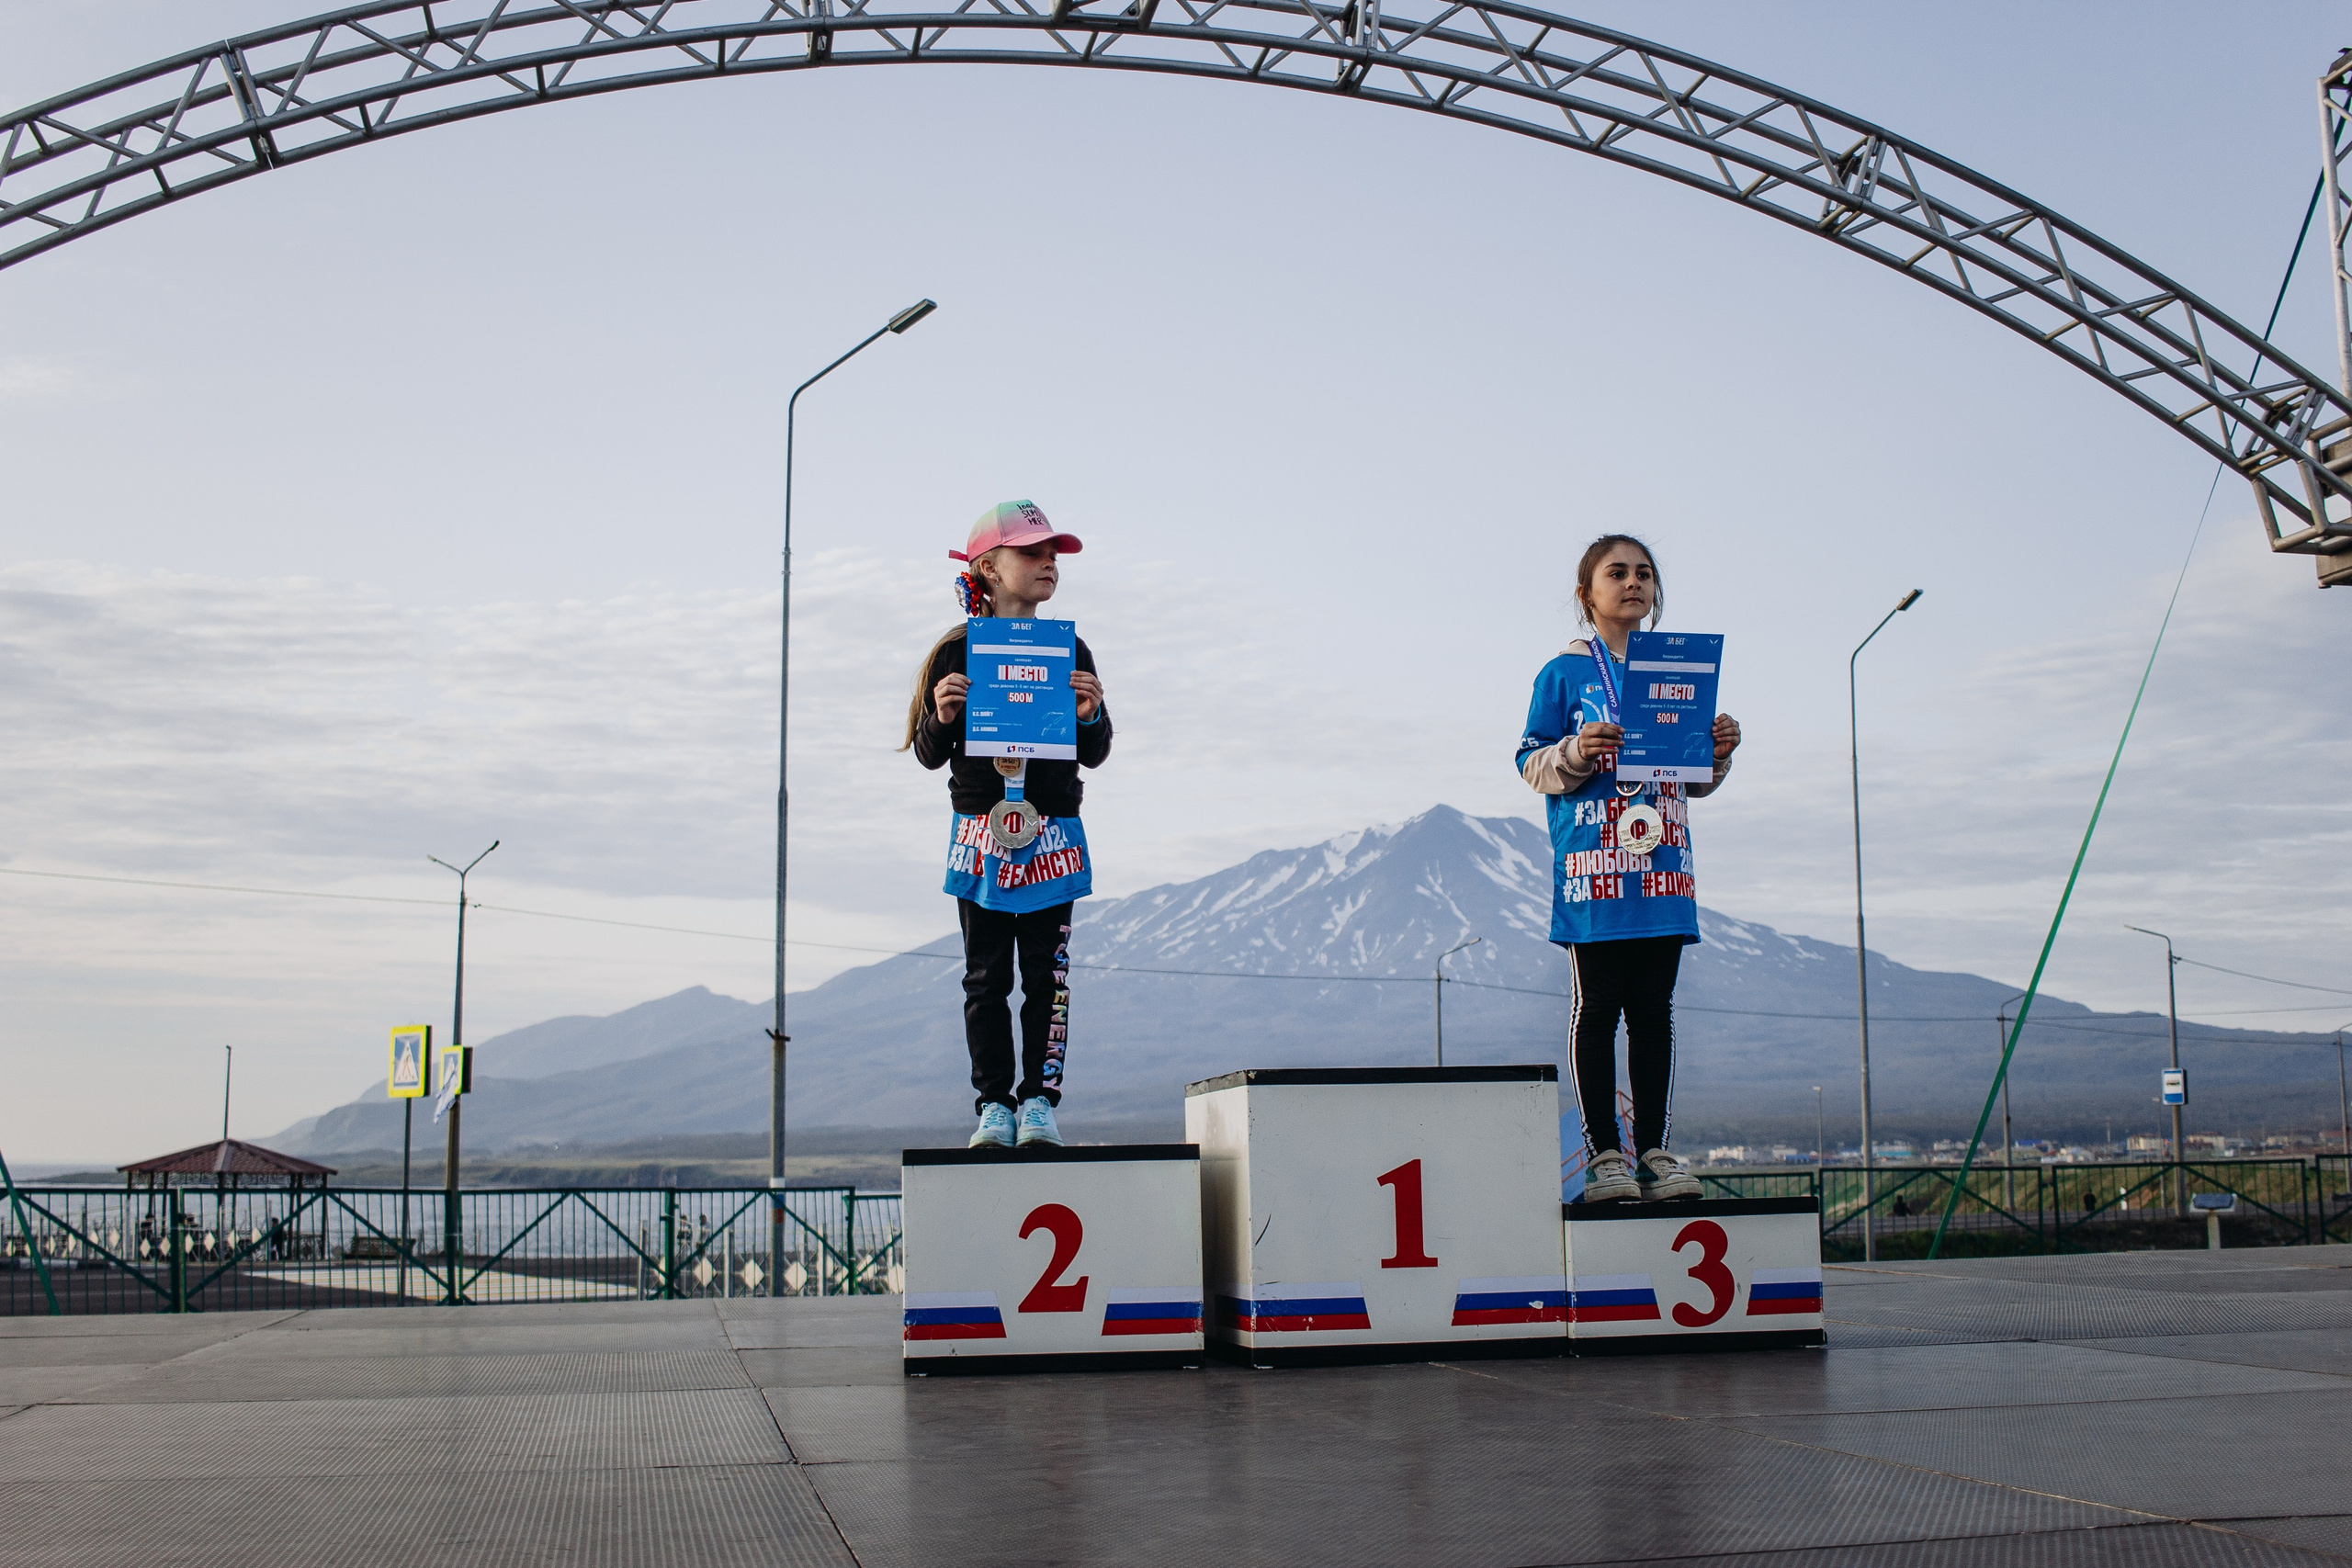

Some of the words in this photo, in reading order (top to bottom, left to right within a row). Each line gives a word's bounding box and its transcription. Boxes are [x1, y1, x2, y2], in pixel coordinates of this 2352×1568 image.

[1008, 665, 1048, 682] МЕСТО
[1009, 692, 1025, 703] 500
[1025, 693, 1034, 704] М
[1659, 683, 1695, 701] МЕСТО
[1656, 713, 1671, 724] 500
[1671, 713, 1679, 724] М
[1520, 737, 1540, 750] СБ
[1575, 796, 1629, 827] #ЗАБЕ
[1565, 847, 1653, 879] #ЛЮБОВЬ
[1563, 874, 1624, 904] #ЗАБЕГ
[1642, 872, 1696, 901] #ЕДИНС
[1042, 988, 1070, 1092] ENERGY
[1376, 1158, 1439, 1269] 1
[1018, 1203, 1089, 1314] 2
[1671, 1220, 1735, 1326] 3
